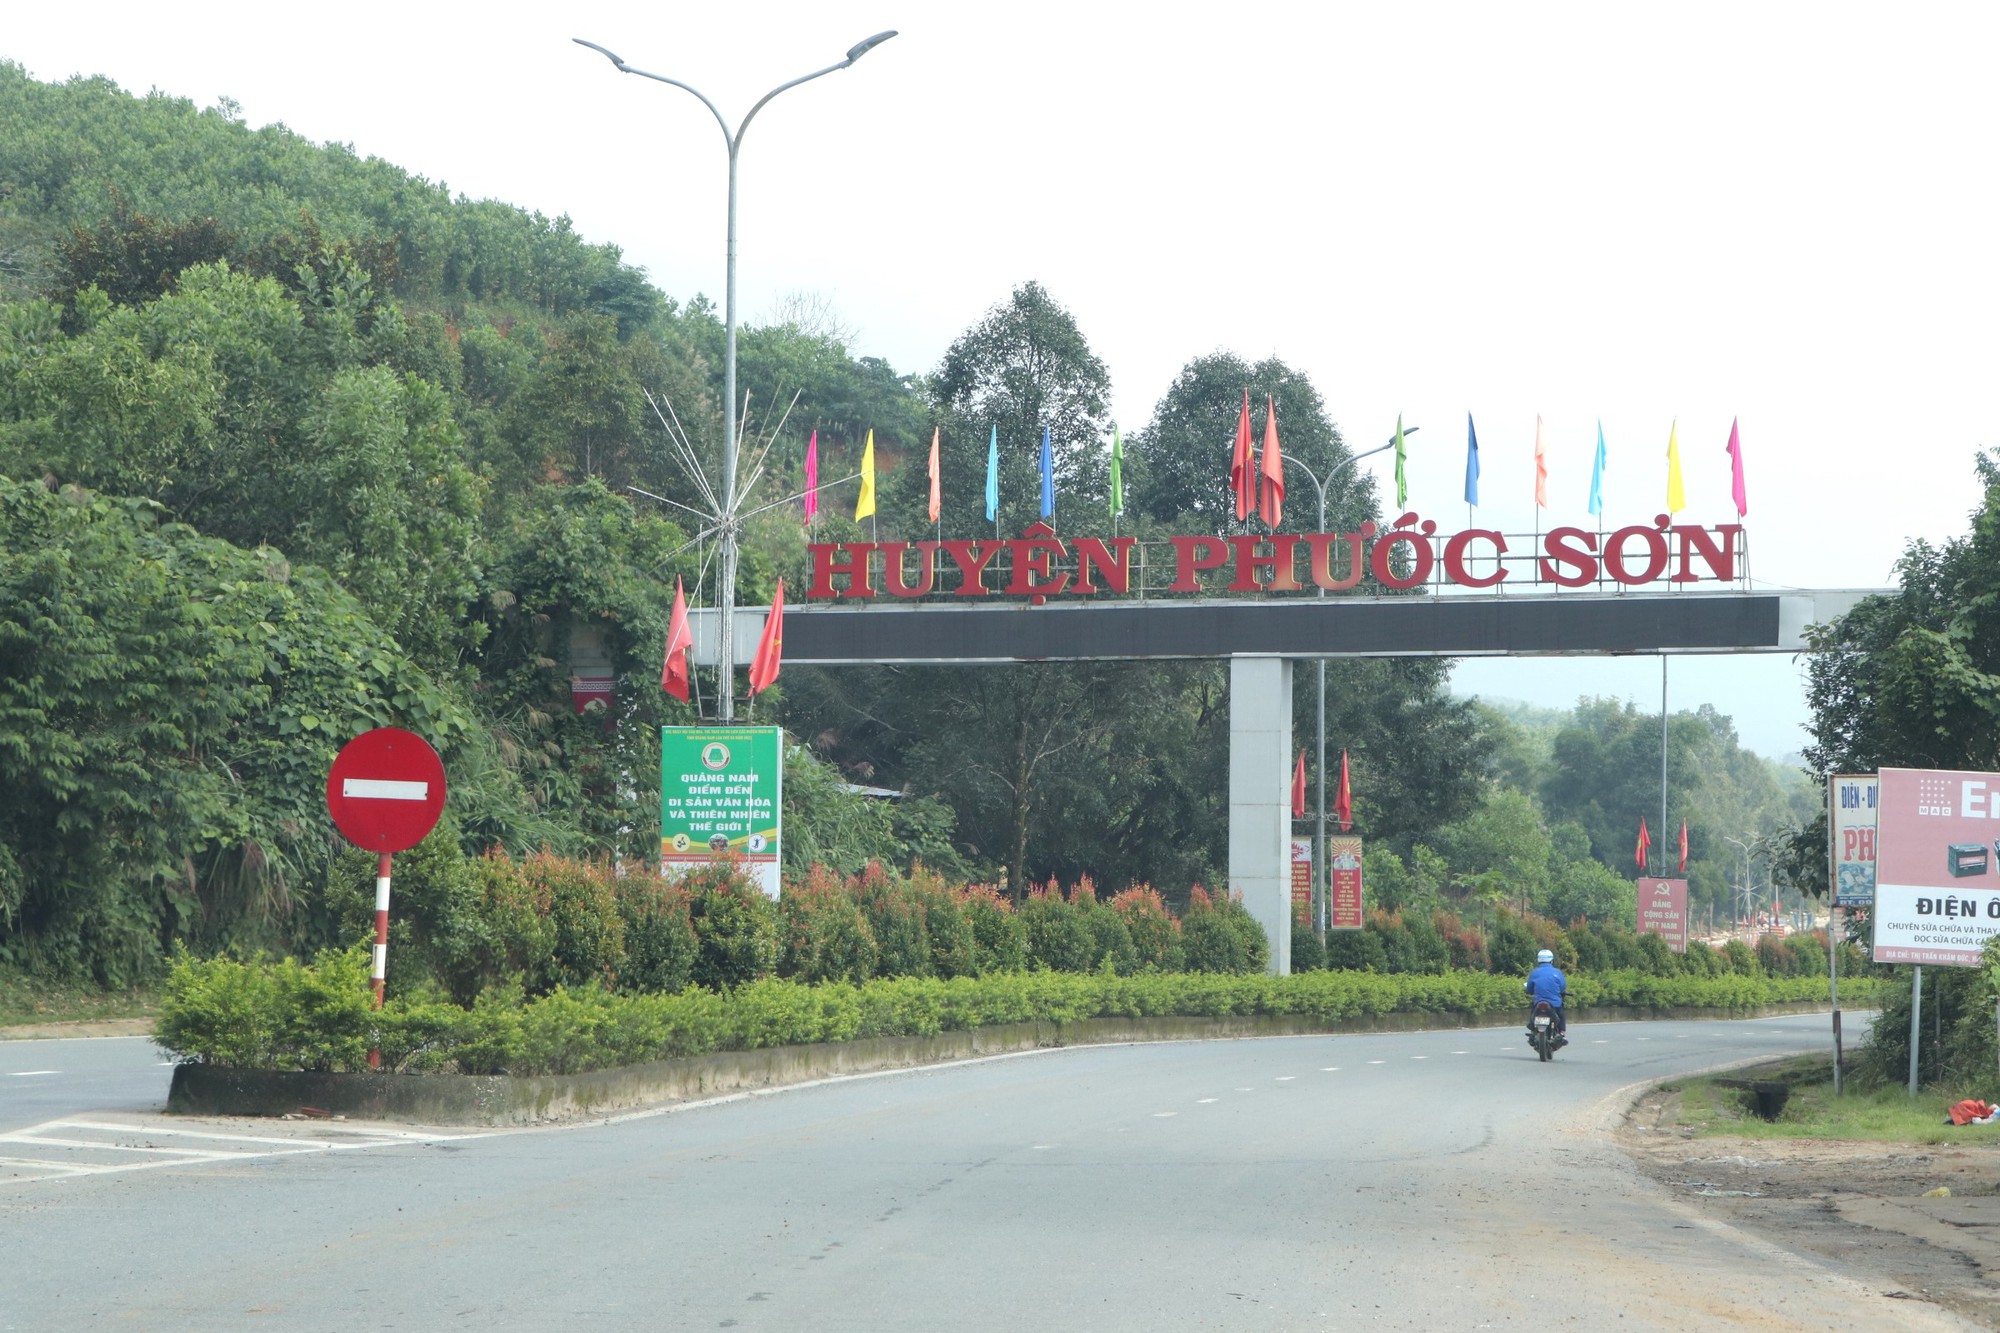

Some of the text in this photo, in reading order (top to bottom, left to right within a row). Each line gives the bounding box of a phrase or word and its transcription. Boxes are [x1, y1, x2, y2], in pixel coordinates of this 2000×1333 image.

[807, 511, 1743, 606] HUYỆN PHƯỚC SƠN
[681, 772, 759, 783] QUẢNG NAM
[688, 784, 751, 795] ĐIỂM ĐẾN
[685, 797, 712, 807] SẢN
[715, 797, 742, 807] VĂN
[745, 797, 771, 807] HÓA
[1841, 782, 1860, 813] ĐIỆN
[1867, 786, 1877, 809] ĐI
[669, 809, 770, 819] VÀ THIÊN NHIÊN
[1920, 806, 1951, 816] MAC
[688, 820, 712, 831] THẾ
[716, 821, 742, 831] GIỚI
[1652, 899, 1672, 908] ĐẢNG
[1915, 895, 1977, 921] ĐIỆN
[1664, 910, 1680, 919] SẢN
[1661, 922, 1677, 930] NAM
[1887, 922, 1998, 935] CHUYÊN SỬA CHỮA VÀ THAY
[1914, 934, 1931, 944] ĐỌC
[1933, 934, 1949, 944] SỬA
